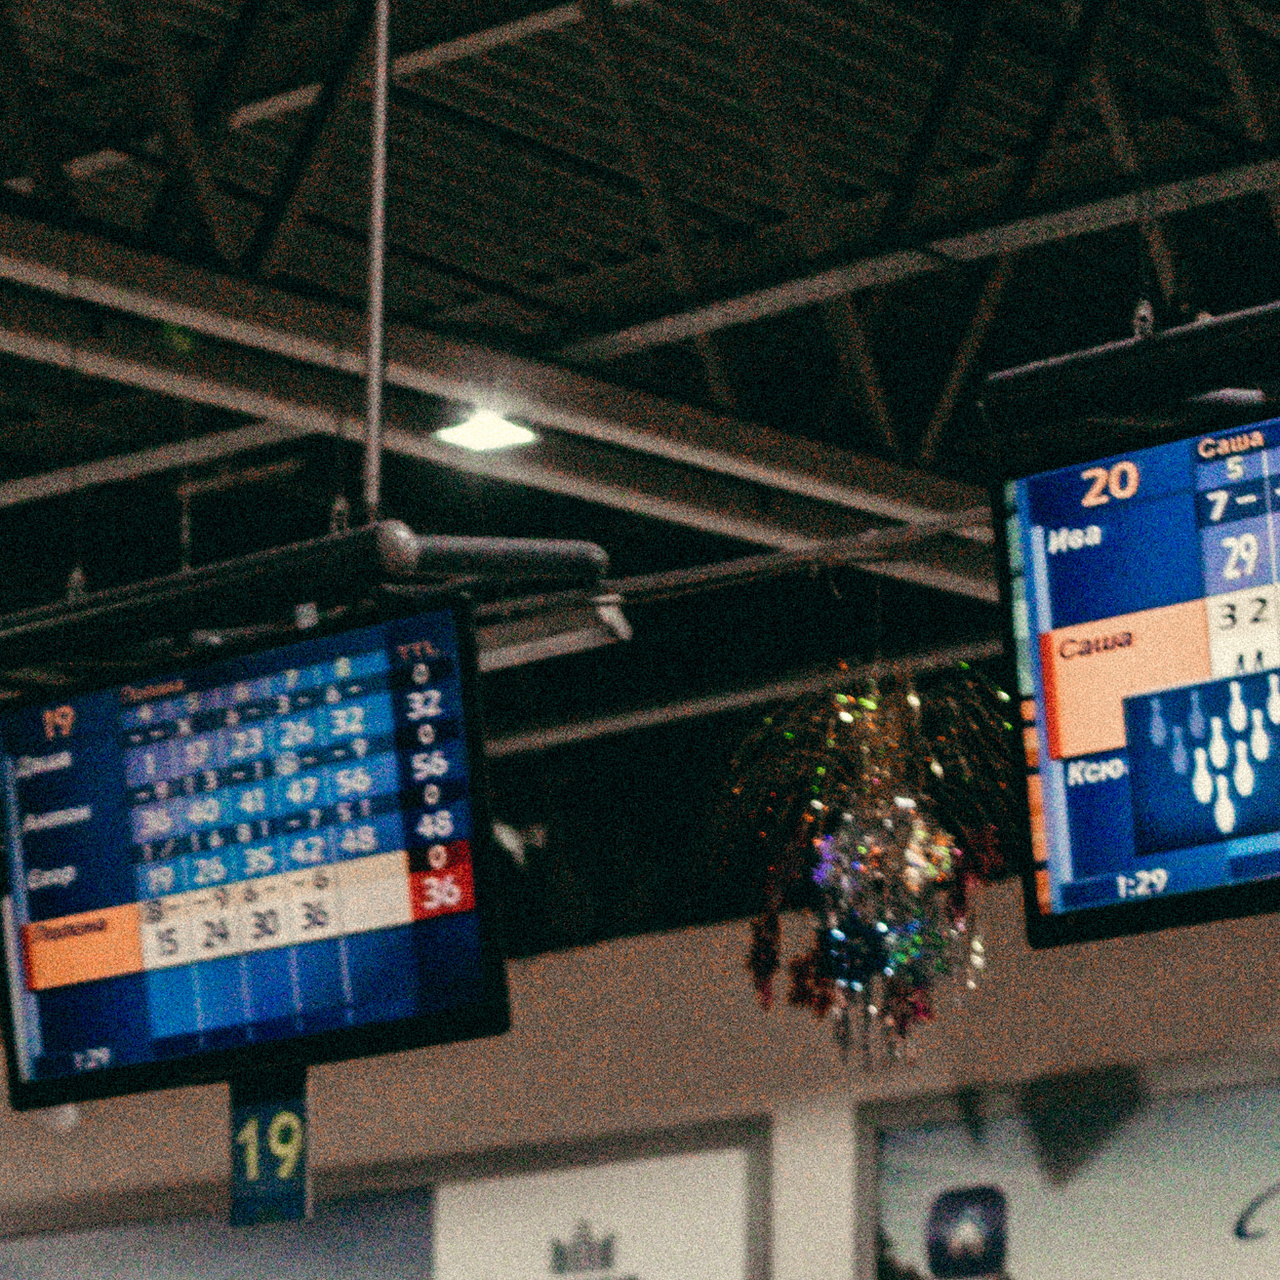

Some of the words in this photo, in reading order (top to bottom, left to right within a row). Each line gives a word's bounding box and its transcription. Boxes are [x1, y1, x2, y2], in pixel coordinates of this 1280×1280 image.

[1198, 432, 1264, 458] Саша
[1081, 461, 1139, 507] 20
[1207, 490, 1229, 521] 7
[1223, 533, 1258, 579] 29
[1221, 602, 1237, 629] 3
[1252, 598, 1268, 624] 2
[1059, 632, 1133, 660] Саша
[406, 689, 442, 720] 32
[43, 705, 76, 740] 19
[331, 705, 364, 736] 32
[411, 751, 448, 781] 56
[286, 776, 318, 803] 47
[336, 767, 371, 796] 56
[340, 824, 377, 852] 48
[416, 810, 453, 839] 48
[428, 844, 448, 870] 0
[423, 874, 462, 911] 36
[1117, 868, 1168, 898] 1:29
[201, 918, 231, 950] 24
[250, 908, 279, 940] 30
[300, 901, 331, 932] 36
[237, 1112, 304, 1181] 19
